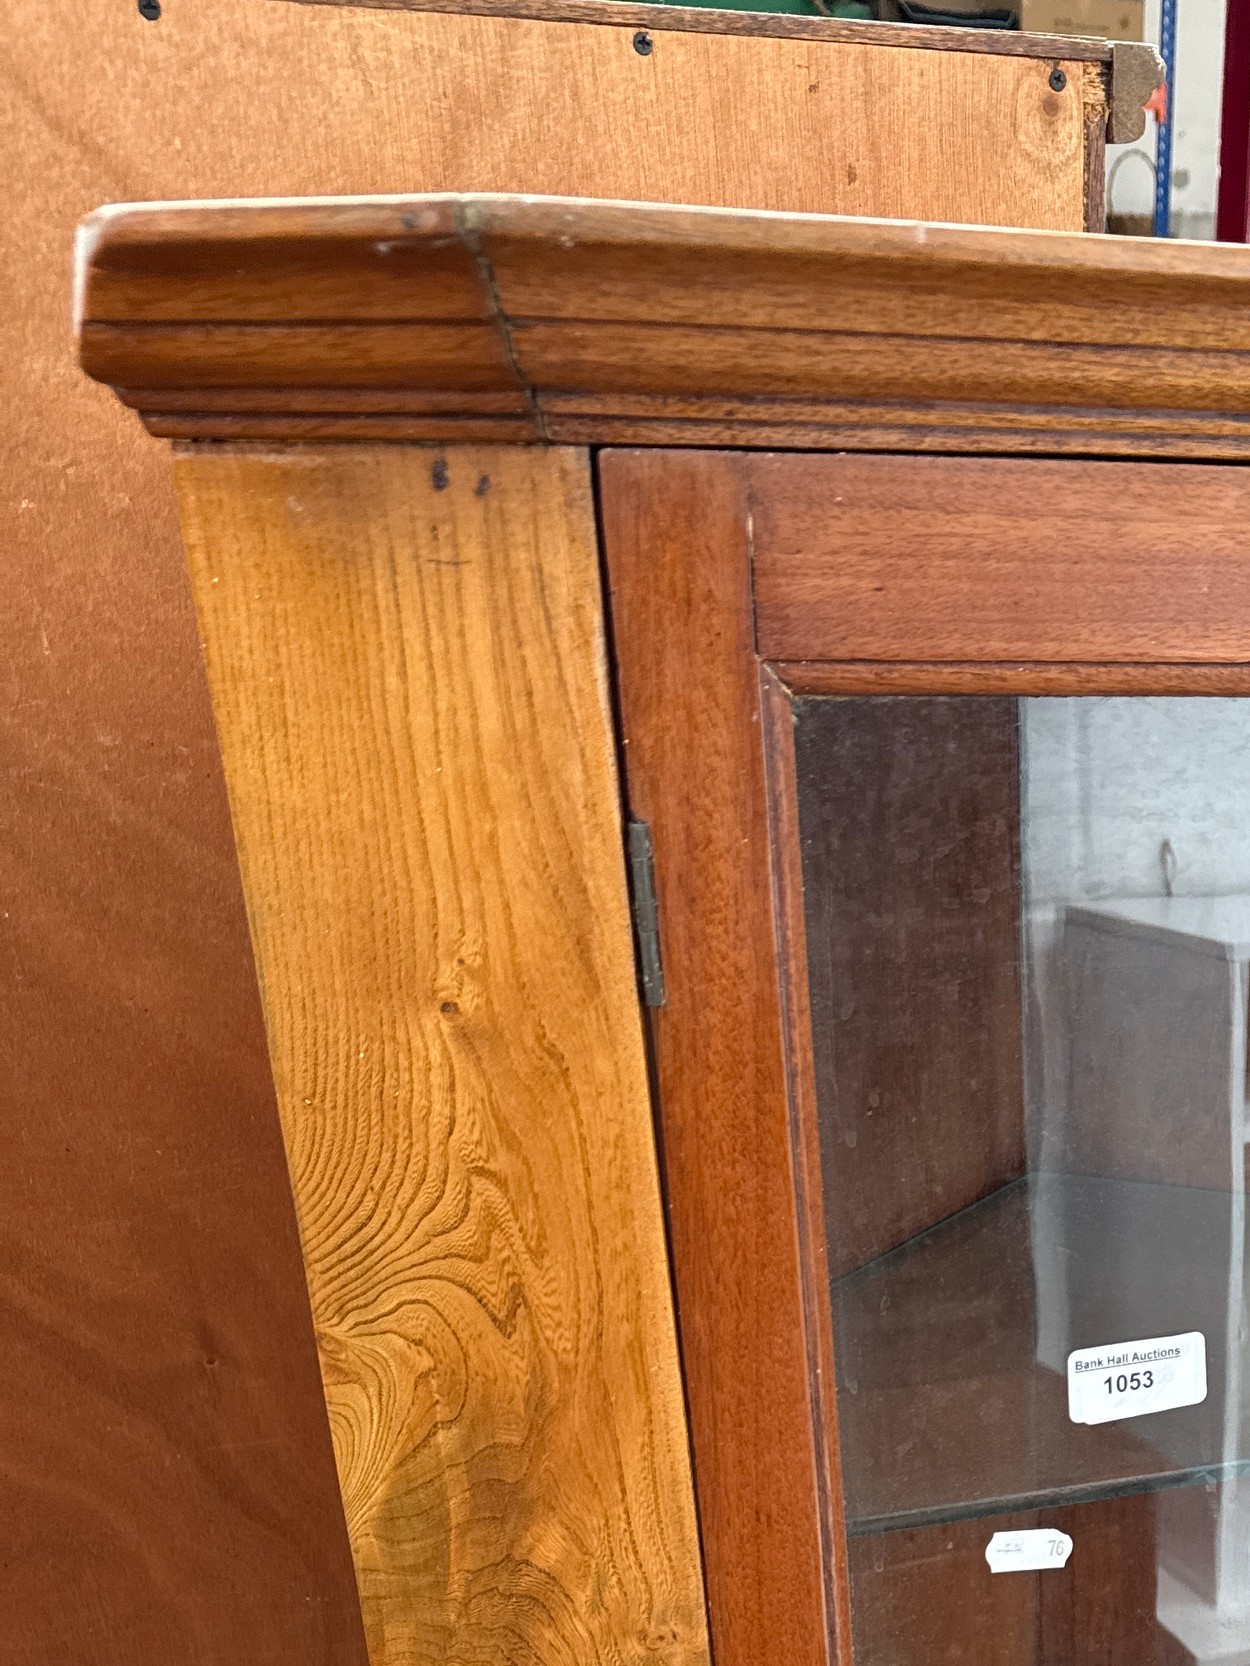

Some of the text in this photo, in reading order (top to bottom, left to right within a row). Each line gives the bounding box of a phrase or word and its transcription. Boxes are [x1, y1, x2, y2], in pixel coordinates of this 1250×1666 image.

[1075, 1346, 1181, 1371] Bank Hall Auctions
[1103, 1370, 1154, 1395] 1053
[1047, 1539, 1065, 1557] 76
